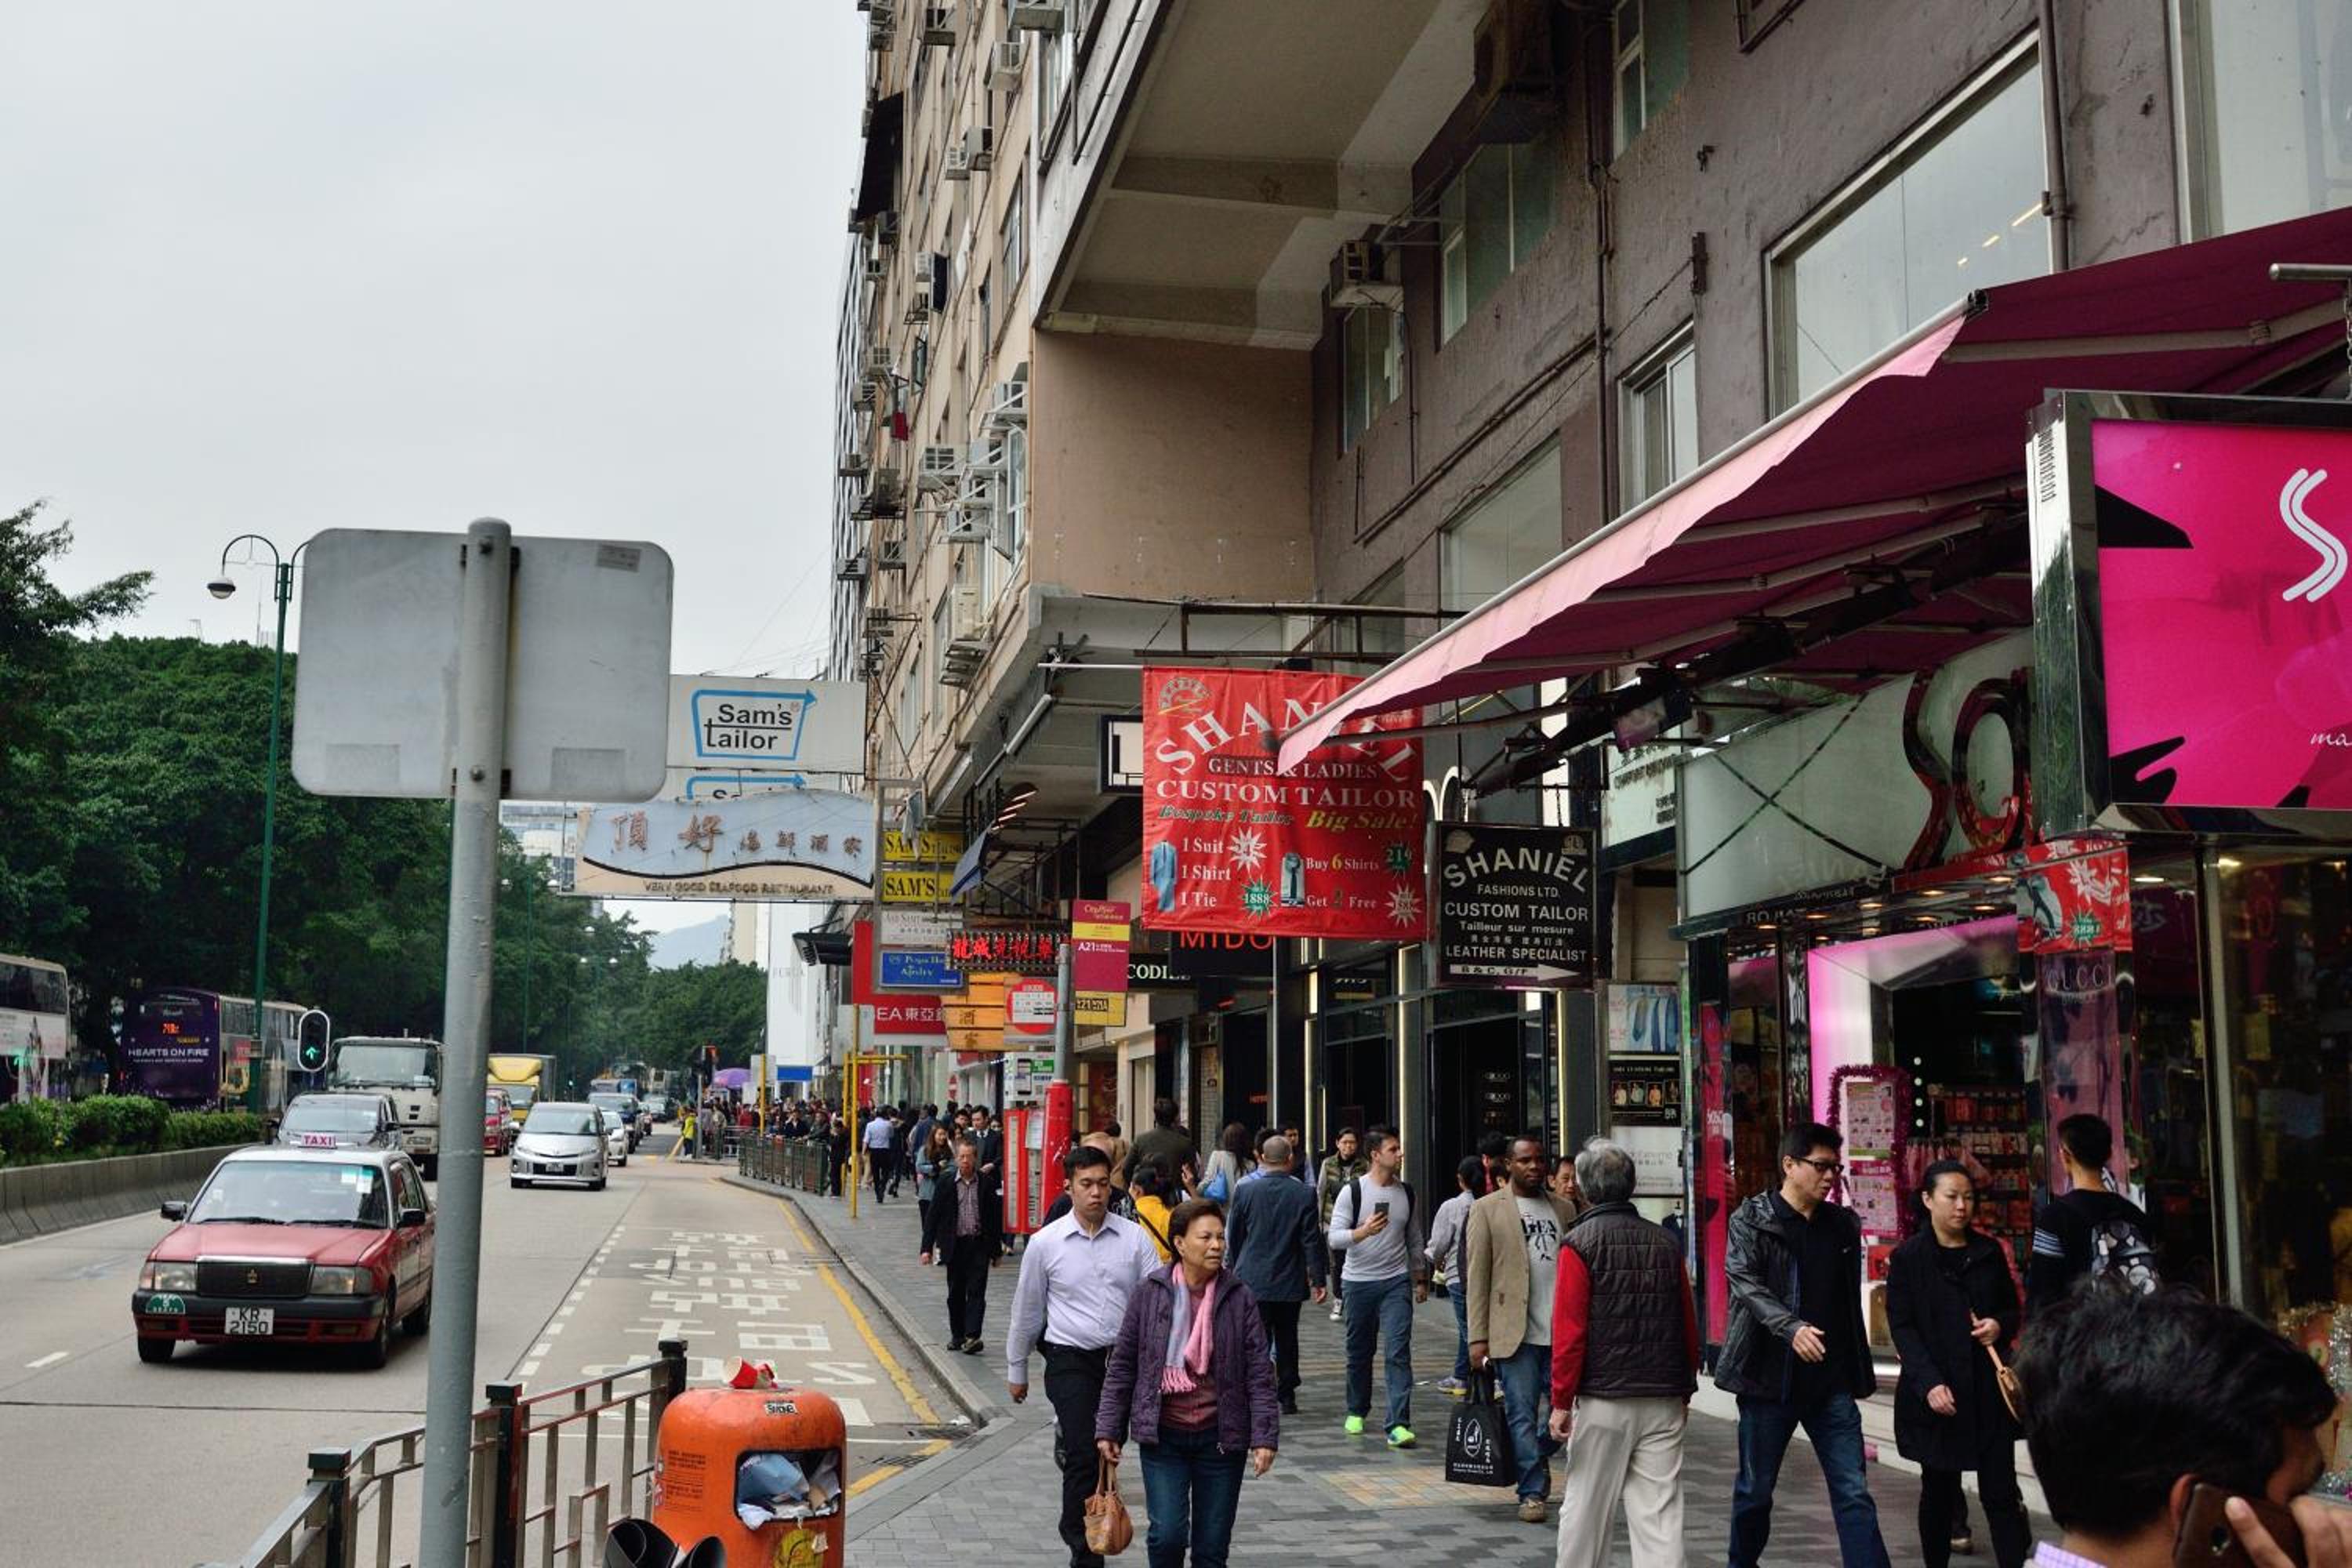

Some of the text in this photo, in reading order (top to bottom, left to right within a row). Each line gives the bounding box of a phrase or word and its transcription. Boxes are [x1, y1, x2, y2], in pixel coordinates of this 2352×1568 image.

[718, 704, 793, 725] Sam's
[706, 718, 778, 750] tailor
[1303, 762, 1377, 779] LADIES
[1156, 780, 1415, 808] CUSTOM TAILOR
[1158, 804, 1233, 822] Bespoke
[1305, 810, 1347, 831] Big
[1353, 811, 1416, 829] Sale!
[1181, 837, 1189, 852] 1
[1193, 838, 1224, 854] Suit
[1306, 854, 1380, 872] Buy 6 Shirts
[1443, 847, 1588, 893] SHANIEL
[1181, 865, 1231, 881] 1 Shirt
[644, 881, 834, 895] VERY GOOD SEAFOOD RESTAURANT
[885, 877, 935, 896] SAM'S
[1477, 884, 1535, 897] FASHIONS
[1181, 892, 1217, 908] 1 Tie
[1243, 893, 1270, 905] 1888
[1306, 890, 1377, 909] Get 2 Free
[1444, 902, 1588, 922] CUSTOM TAILOR
[1459, 920, 1574, 935] Tailleur sur mesure
[1078, 942, 1095, 952] A21
[1446, 945, 1587, 961] LEATHER SPECIALIST
[877, 1007, 902, 1020] EA
[128, 1048, 209, 1057] HEARTS ON FIRE
[304, 1135, 332, 1145] TAXI
[640, 1273, 802, 1291] BUS
[238, 1308, 260, 1321] KR
[230, 1321, 269, 1334] 2150
